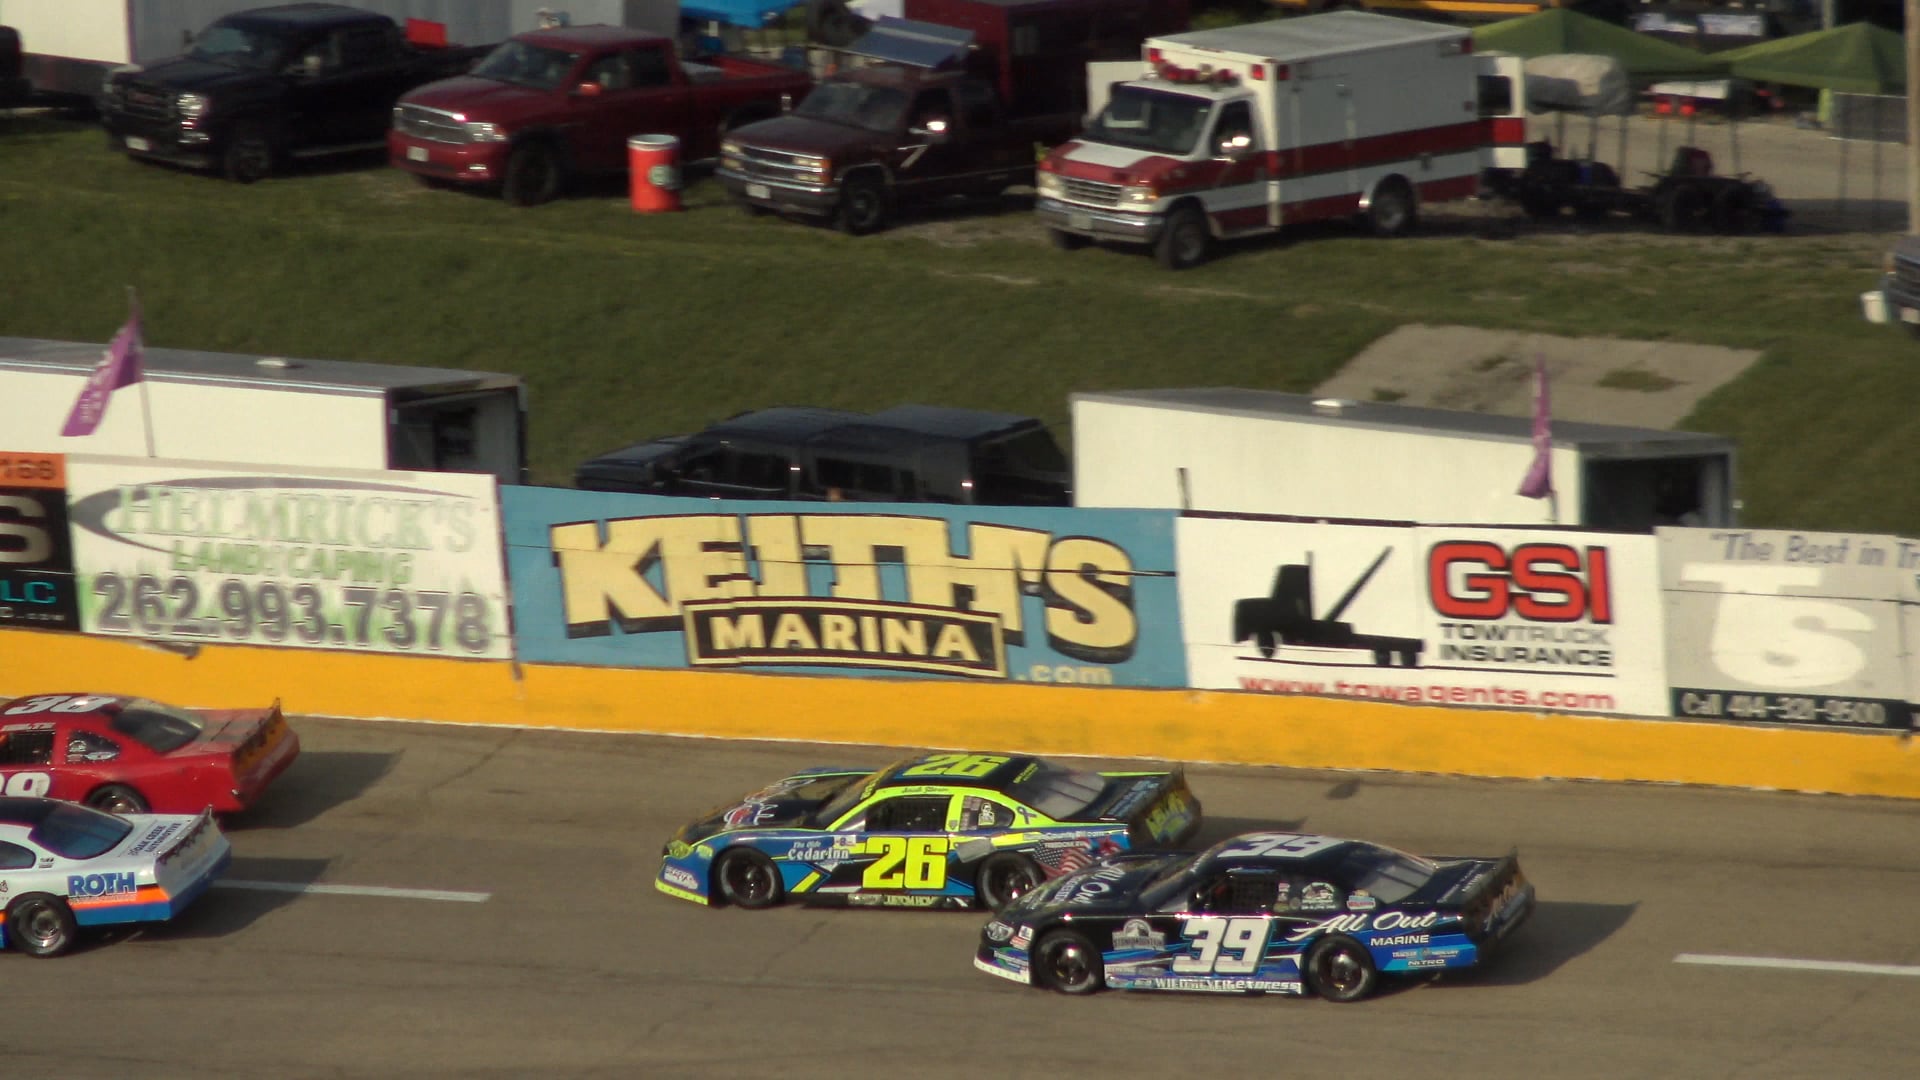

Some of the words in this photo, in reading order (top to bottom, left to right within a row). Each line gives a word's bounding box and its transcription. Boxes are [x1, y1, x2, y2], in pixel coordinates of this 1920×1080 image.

[1785, 534, 1849, 564] Best
[1858, 541, 1886, 567] in
[549, 512, 1138, 662] KEITH'S
[1428, 540, 1614, 625] GSI
[93, 570, 491, 655] 262.993.7378
[709, 612, 981, 662] MARINA
[1439, 621, 1612, 645] TOWTRUCK
[1439, 643, 1615, 667] INSURANCE
[1237, 674, 1616, 710] www.towagents.com
[902, 753, 1011, 778] 26
[1216, 834, 1345, 858] 39
[861, 836, 947, 890] 26
[67, 871, 137, 898] ROTH
[1373, 911, 1438, 932] Out
[1171, 917, 1272, 974] 39
[1370, 934, 1431, 947] MARINE
